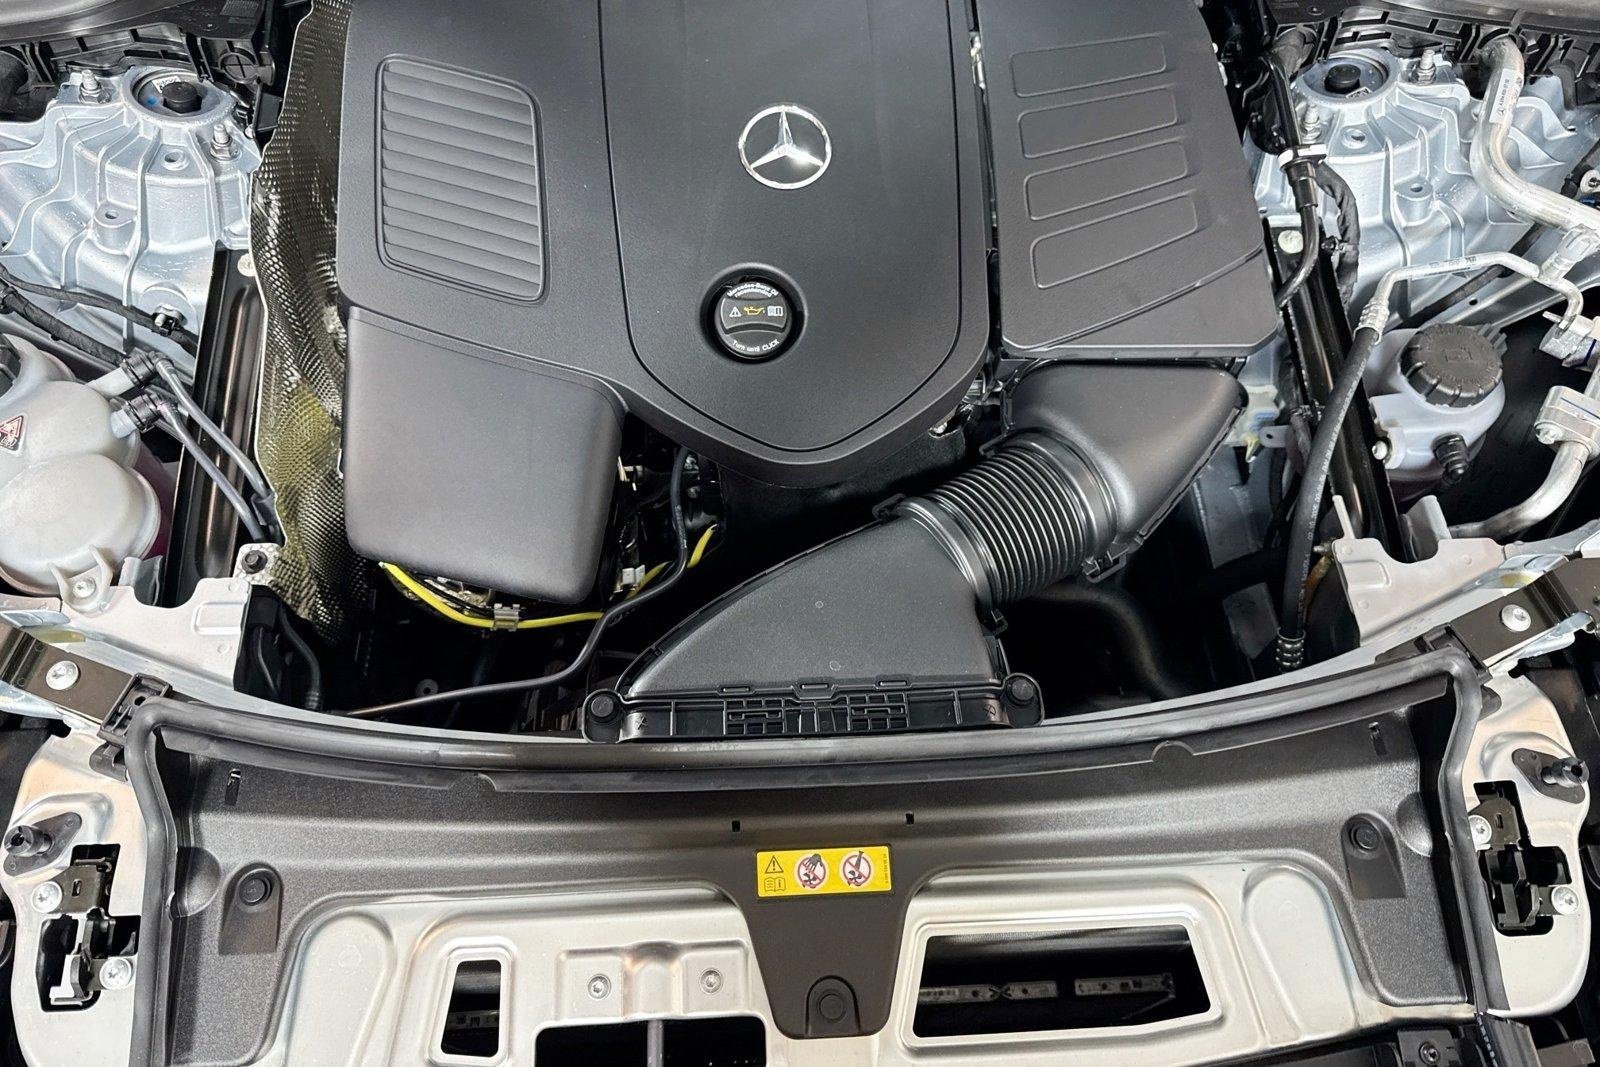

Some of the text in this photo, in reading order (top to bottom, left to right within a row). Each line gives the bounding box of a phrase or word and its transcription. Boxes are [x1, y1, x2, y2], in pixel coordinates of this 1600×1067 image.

[727, 282, 771, 297] Mercedes-Benz
[732, 340, 746, 351] Turn
[762, 338, 780, 351] CLICK
